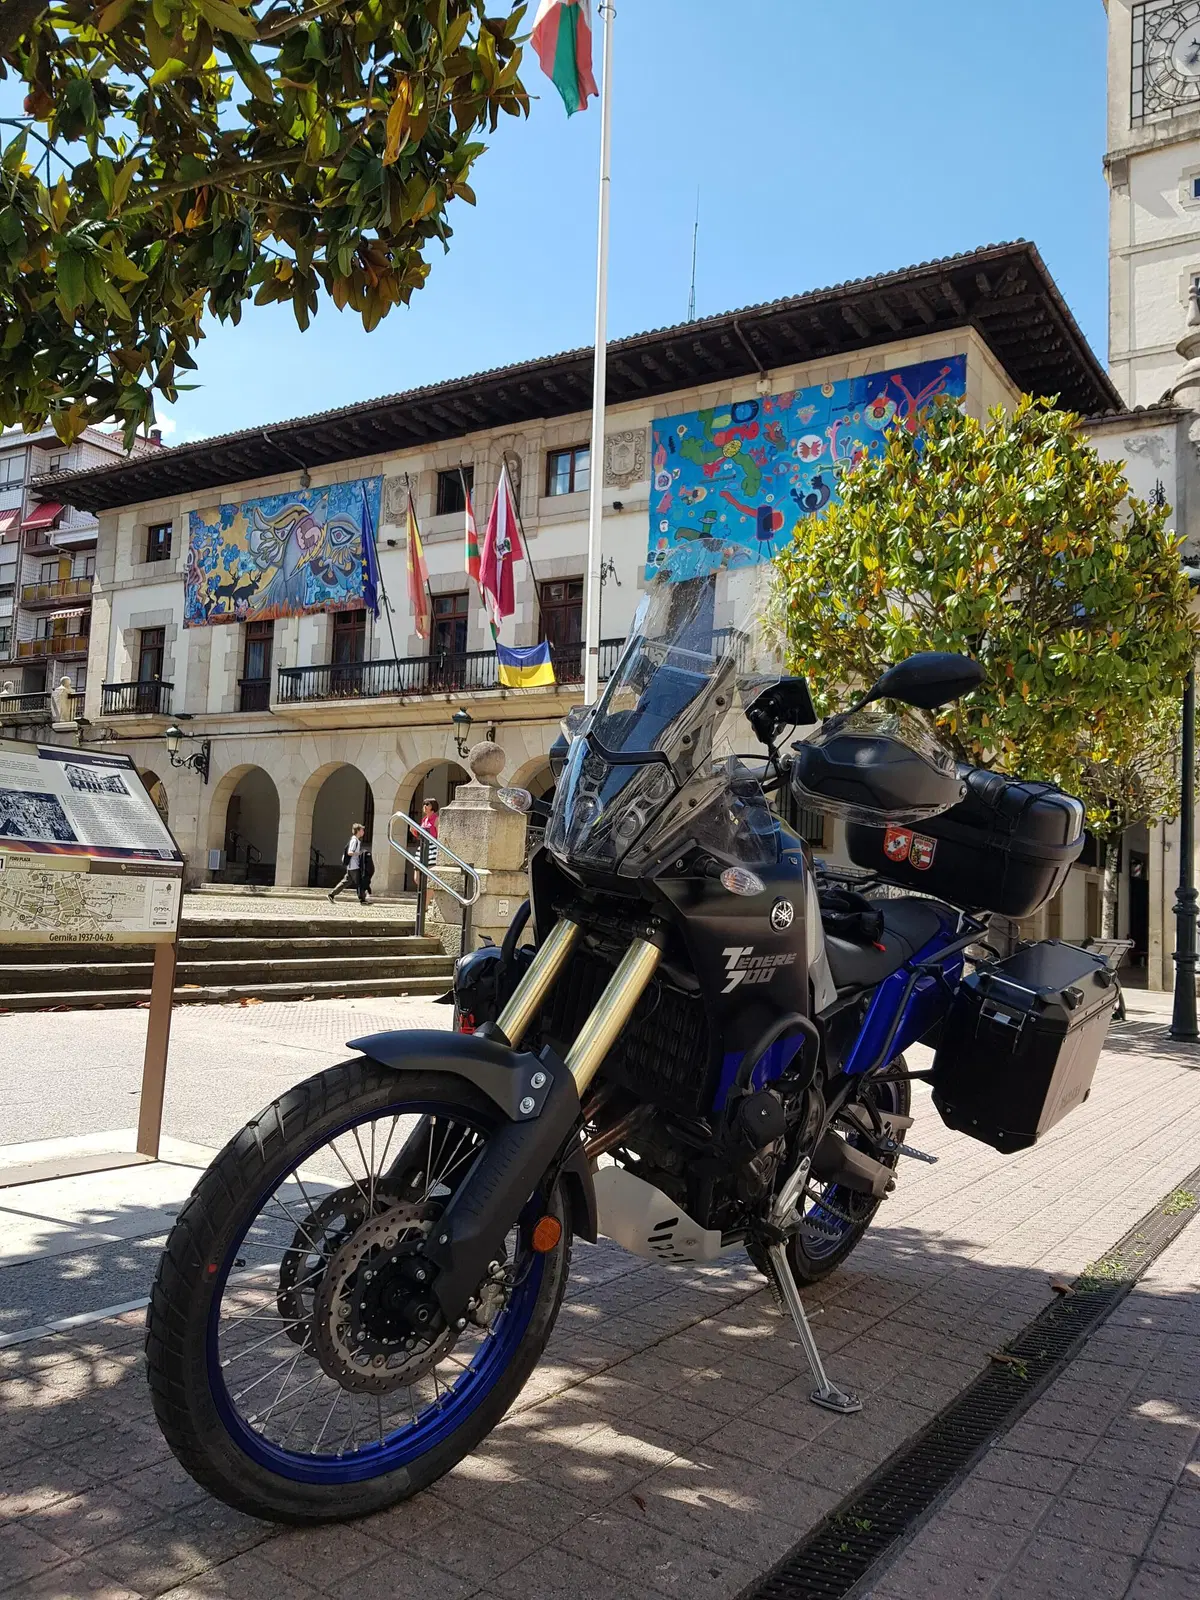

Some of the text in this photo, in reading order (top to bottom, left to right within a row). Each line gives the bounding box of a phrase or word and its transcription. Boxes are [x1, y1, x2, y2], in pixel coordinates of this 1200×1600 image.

[49, 932, 114, 942] Gernika 1937-04-26
[720, 967, 777, 994] 700
